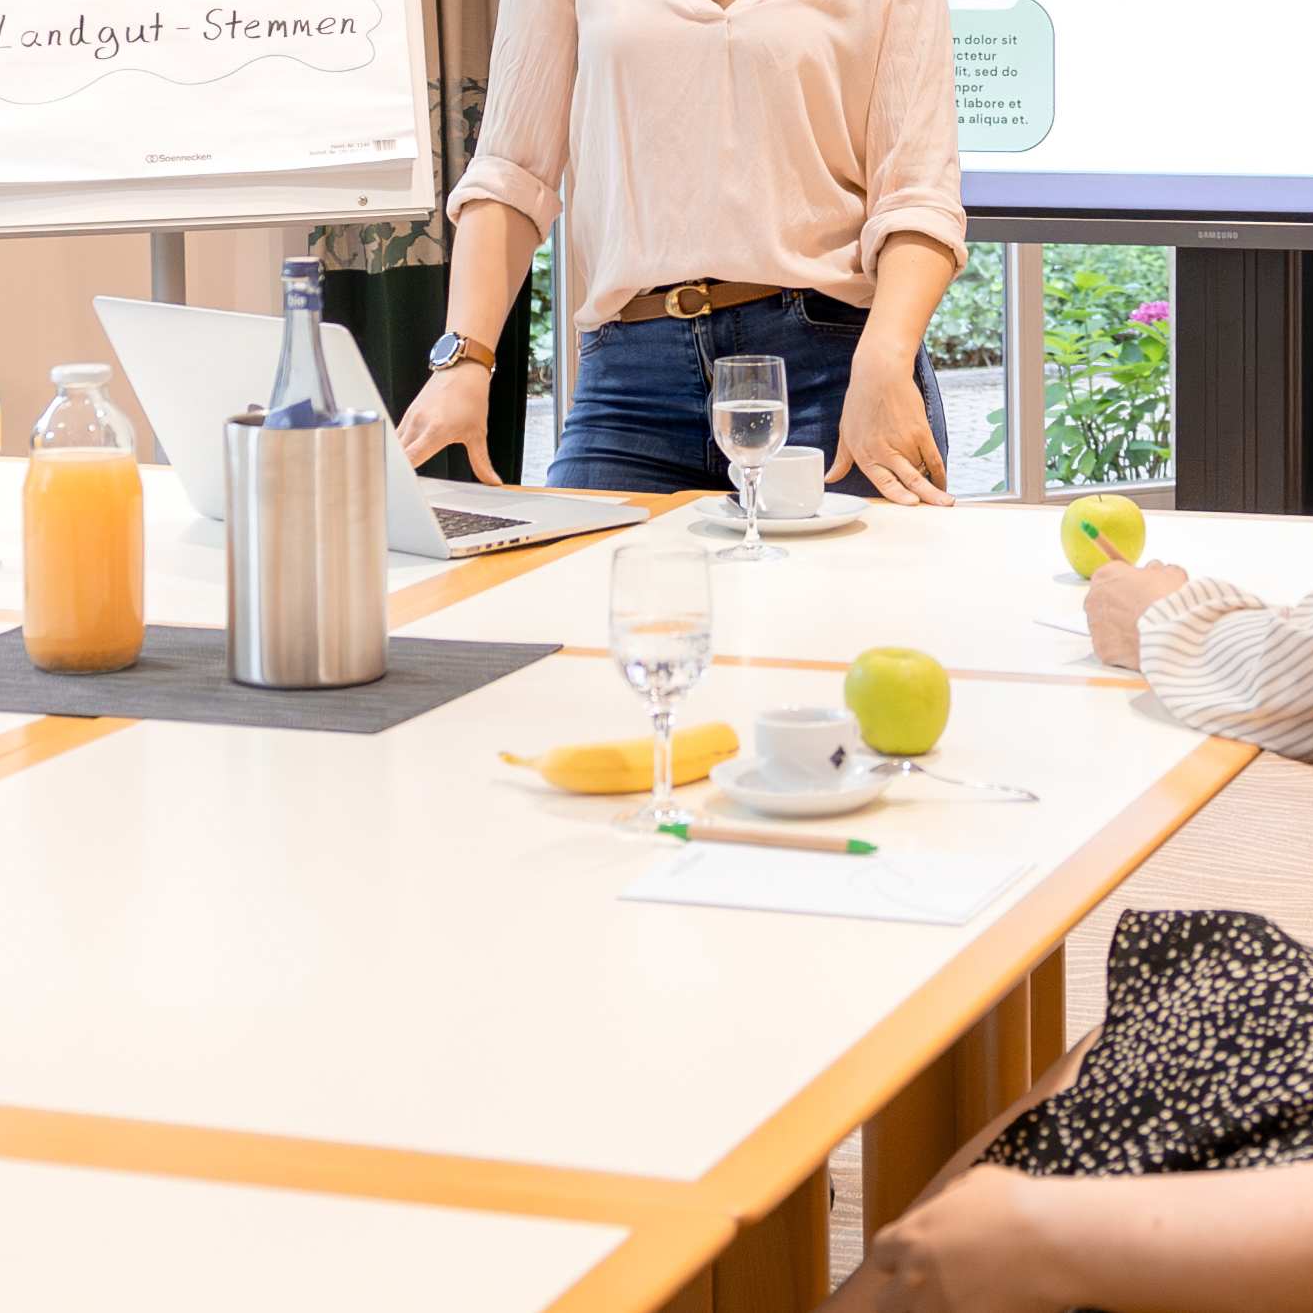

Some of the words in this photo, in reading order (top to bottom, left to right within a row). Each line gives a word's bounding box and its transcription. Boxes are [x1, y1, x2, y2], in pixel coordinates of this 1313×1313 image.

[964, 33, 999, 45] dolor
[1001, 34, 1018, 46] sit
[956, 52, 996, 61] ctetur
[955, 66, 971, 77] lit,
[974, 65, 998, 77] sed
[1001, 65, 1018, 78] do
[963, 97, 1005, 109] labore
[1008, 99, 1022, 109] et
[968, 113, 1008, 127] aliqua
[1011, 115, 1029, 125] et.
